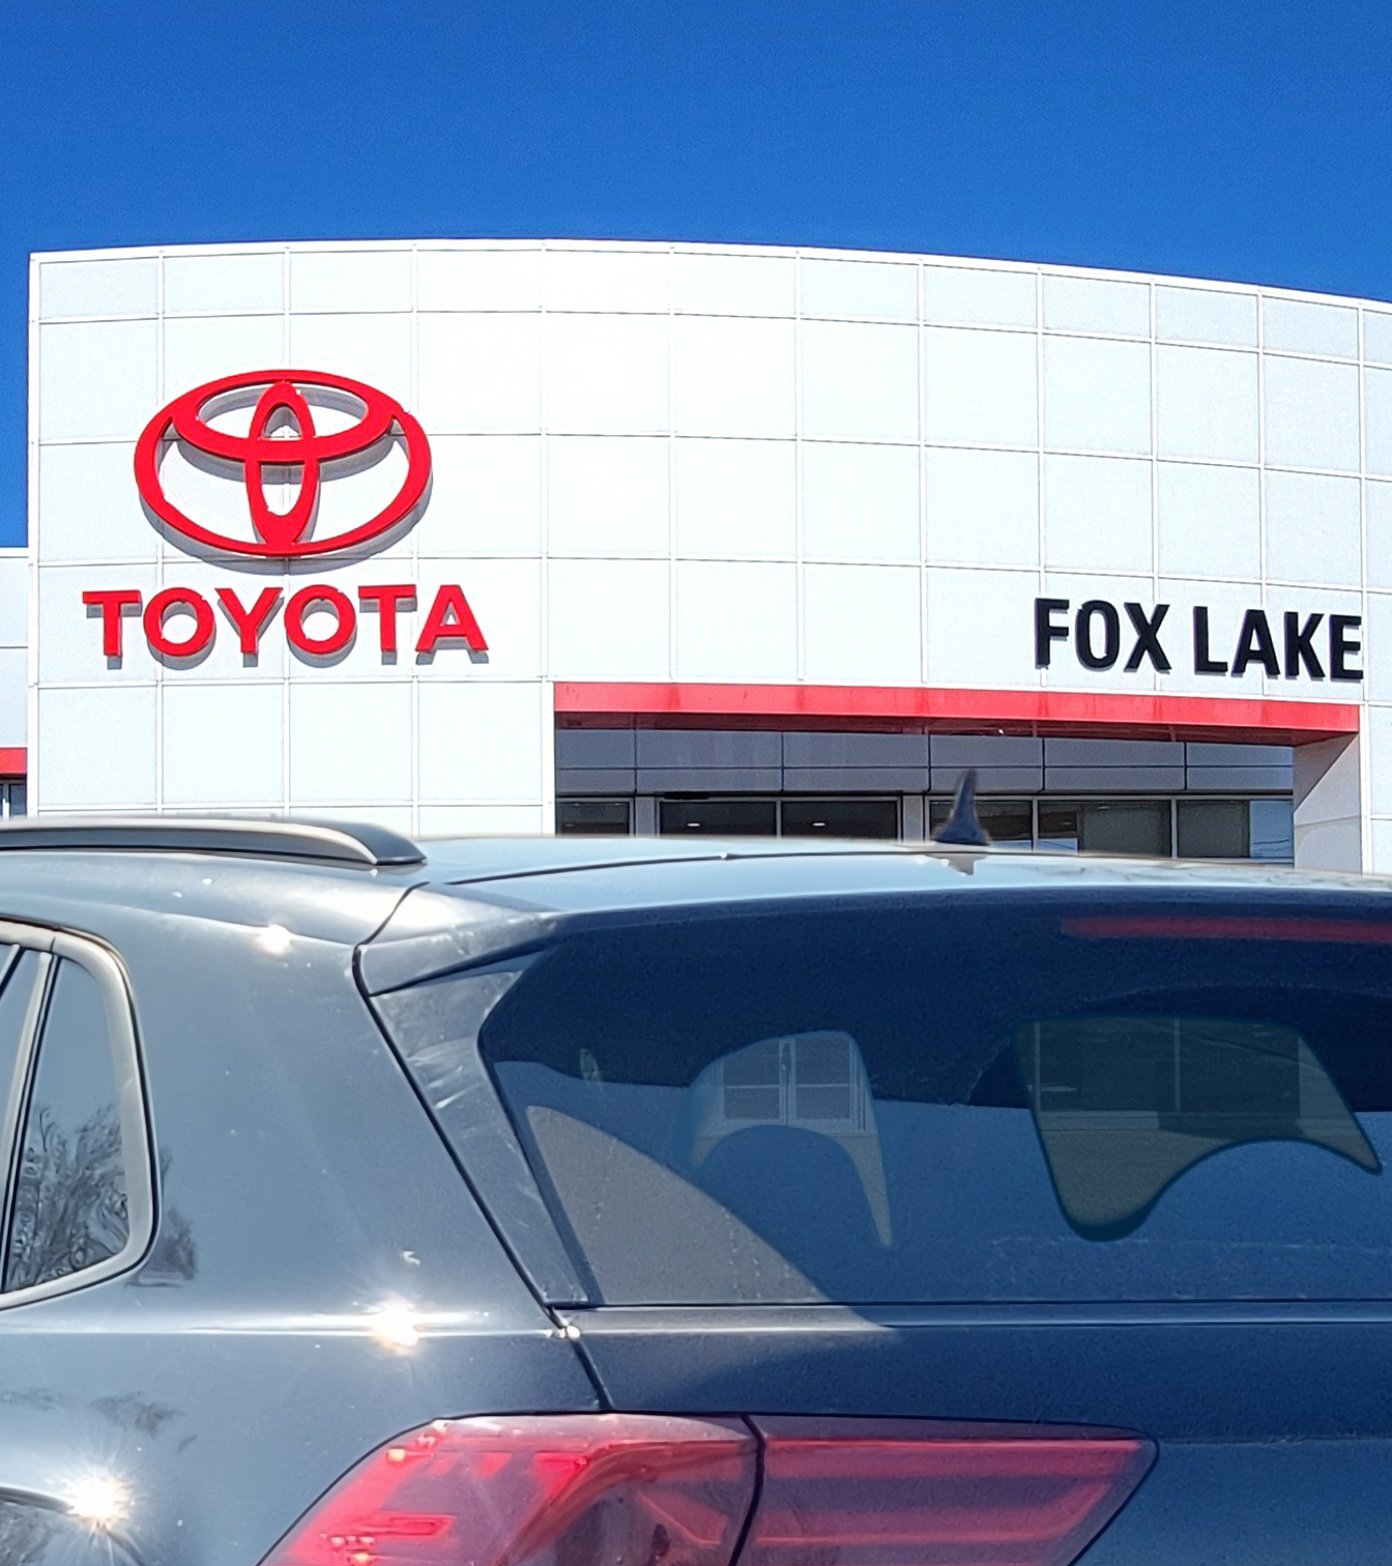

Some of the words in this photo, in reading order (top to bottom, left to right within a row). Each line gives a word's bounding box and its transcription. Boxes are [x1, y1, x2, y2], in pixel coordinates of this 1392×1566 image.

[83, 584, 489, 660] TOYOTA
[1035, 598, 1172, 672] FOX
[1193, 606, 1363, 680] LAKE
